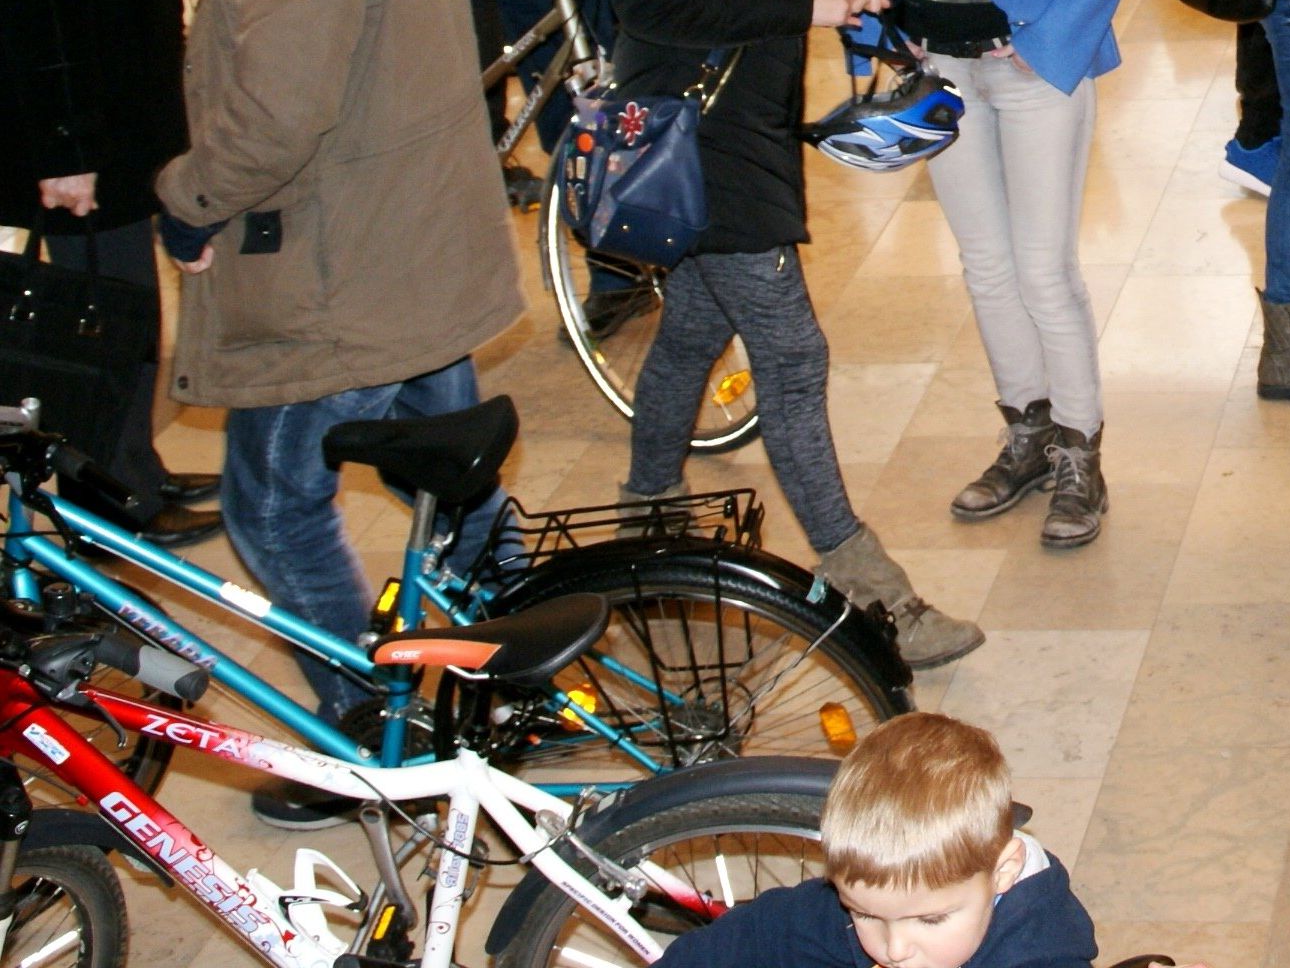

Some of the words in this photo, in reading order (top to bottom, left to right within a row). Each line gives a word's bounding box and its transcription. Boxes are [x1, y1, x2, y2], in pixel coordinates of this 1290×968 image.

[141, 714, 242, 759] ZETA
[100, 791, 266, 933] GENESIS
[615, 921, 629, 936] FOR
